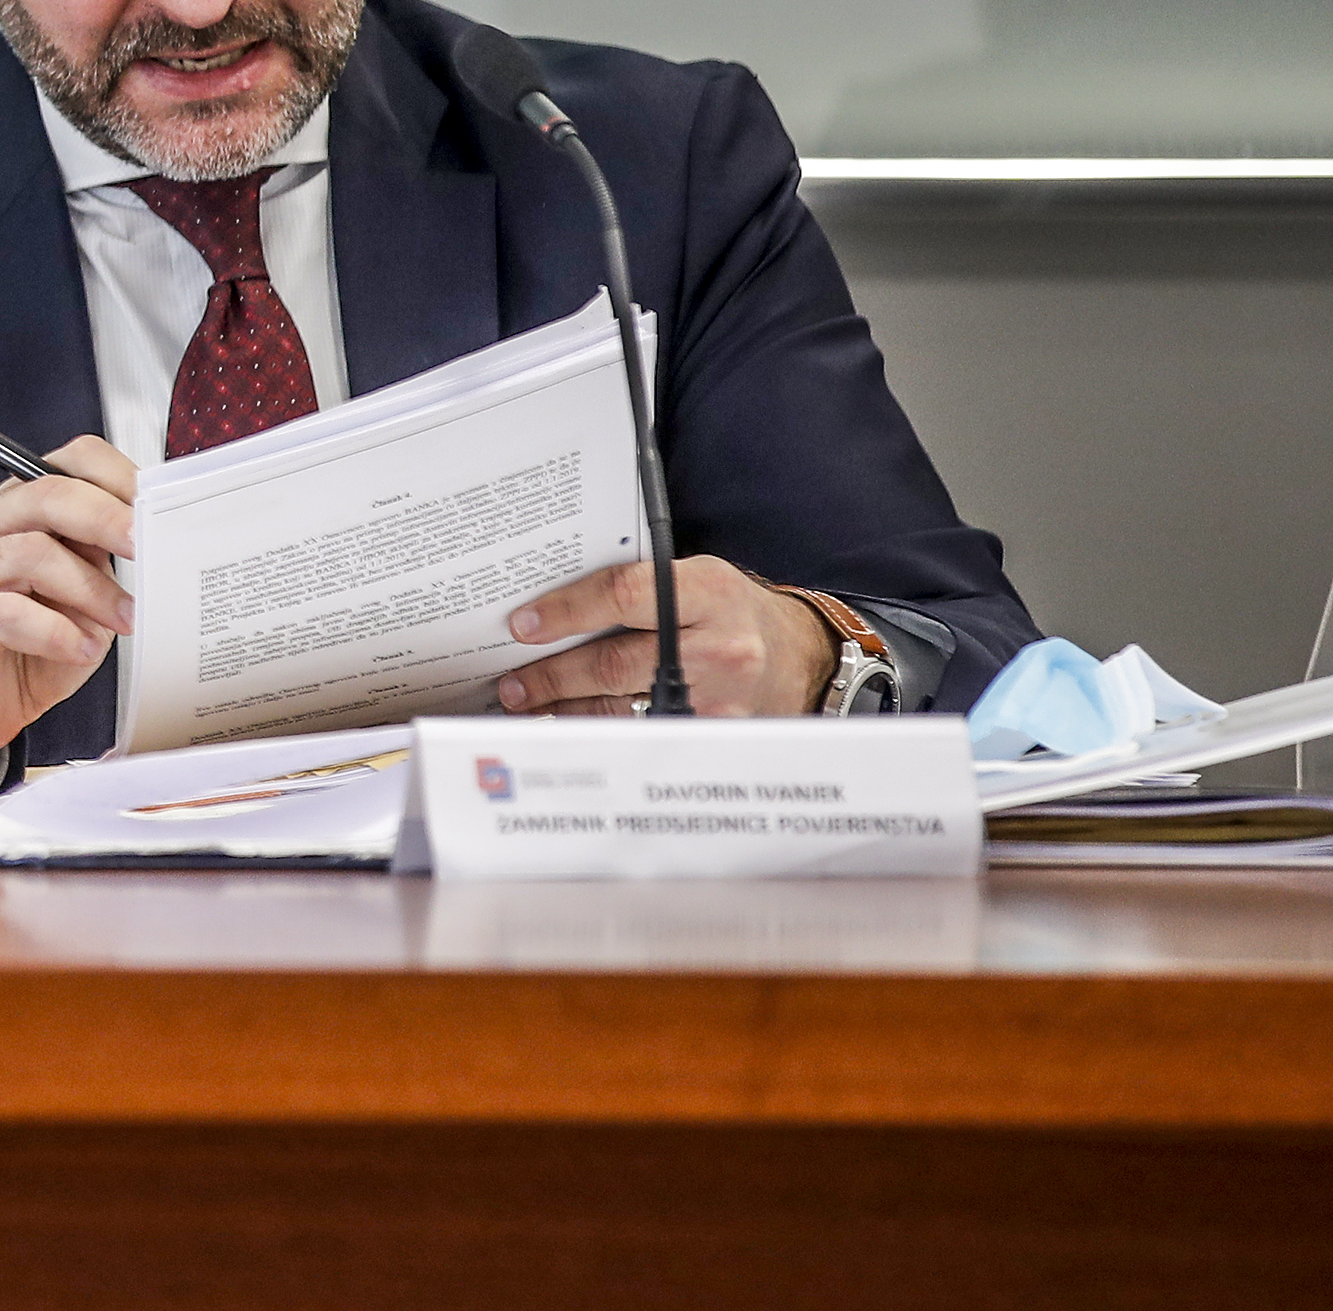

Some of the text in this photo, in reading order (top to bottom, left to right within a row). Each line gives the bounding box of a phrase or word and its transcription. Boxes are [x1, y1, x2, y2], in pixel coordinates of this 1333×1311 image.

[646, 782, 846, 804] DAVORIN IVANJEK
[778, 813, 946, 837] POVJERENSTVA
